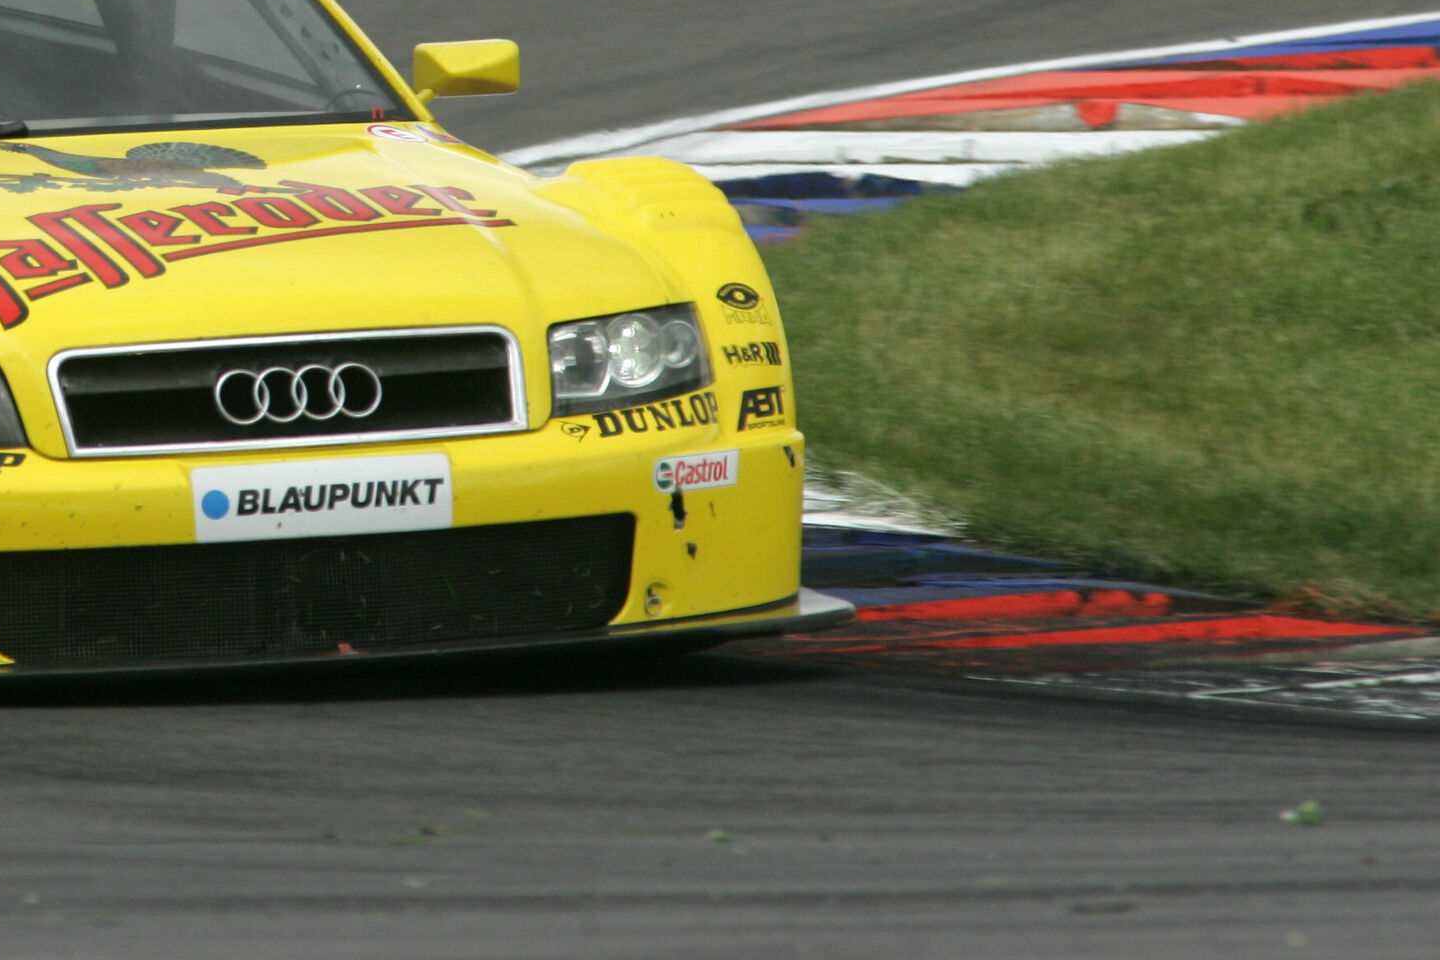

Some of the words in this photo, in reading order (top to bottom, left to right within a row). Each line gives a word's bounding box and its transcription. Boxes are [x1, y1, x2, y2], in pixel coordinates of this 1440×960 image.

[722, 342, 764, 365] H&R
[592, 392, 718, 438] DUNLOP
[737, 386, 784, 432] ABT
[674, 456, 729, 486] Castrol
[236, 477, 444, 517] BLAUPUNKT
